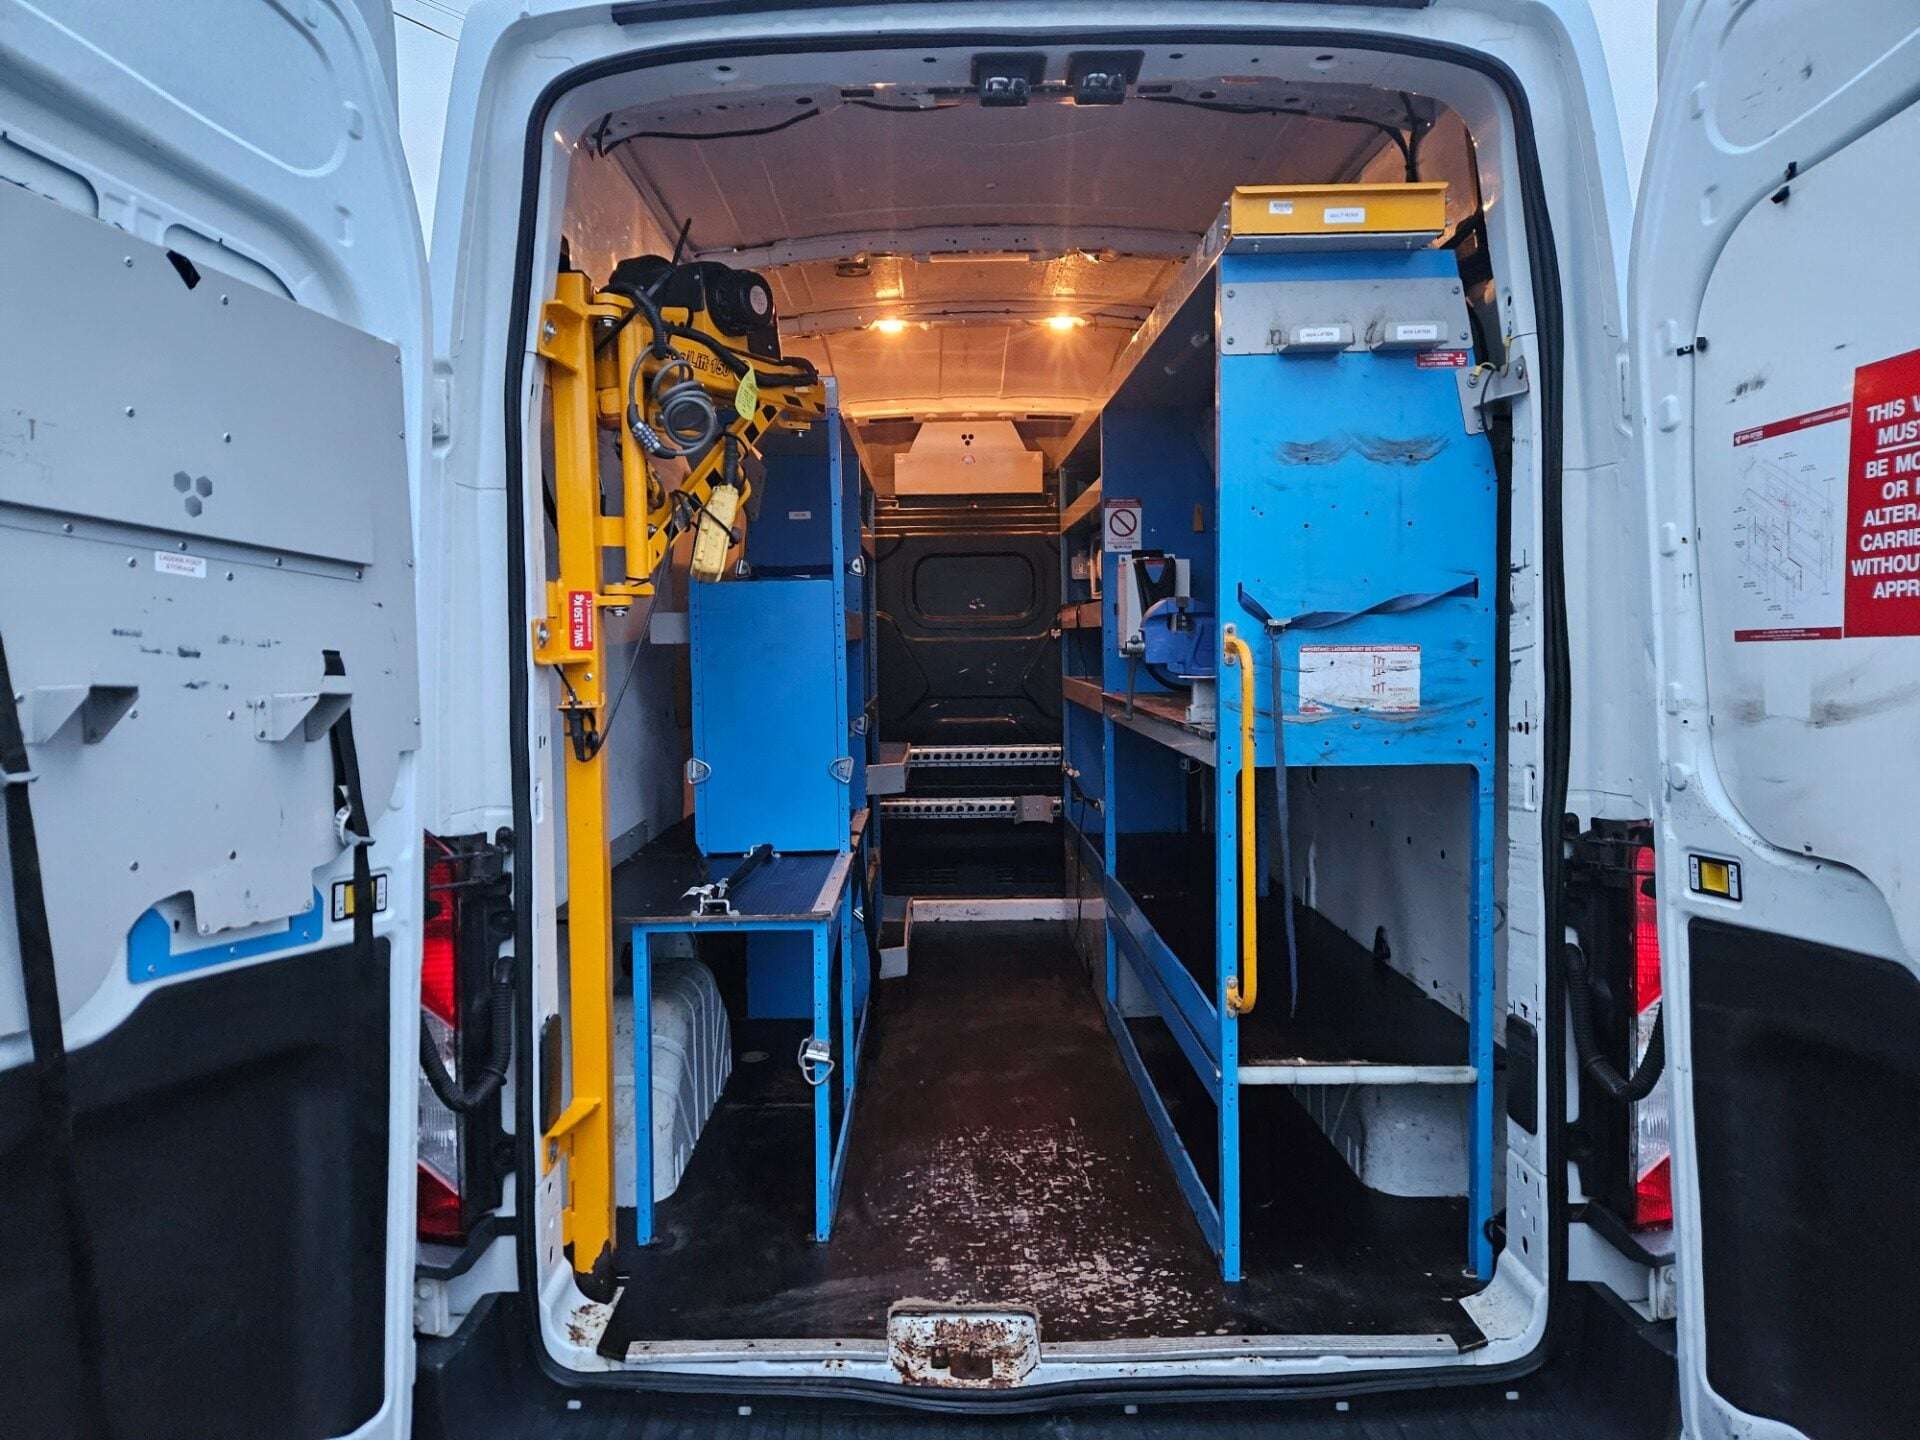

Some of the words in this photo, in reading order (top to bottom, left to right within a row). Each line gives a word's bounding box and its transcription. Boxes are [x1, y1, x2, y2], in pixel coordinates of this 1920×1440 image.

[1866, 398, 1906, 424] THIS
[1877, 419, 1920, 446] MUS
[1864, 458, 1889, 479] BE
[1882, 479, 1909, 500] OR
[1862, 503, 1920, 528] ALTER
[573, 594, 585, 606] Kg
[573, 607, 583, 624] 150
